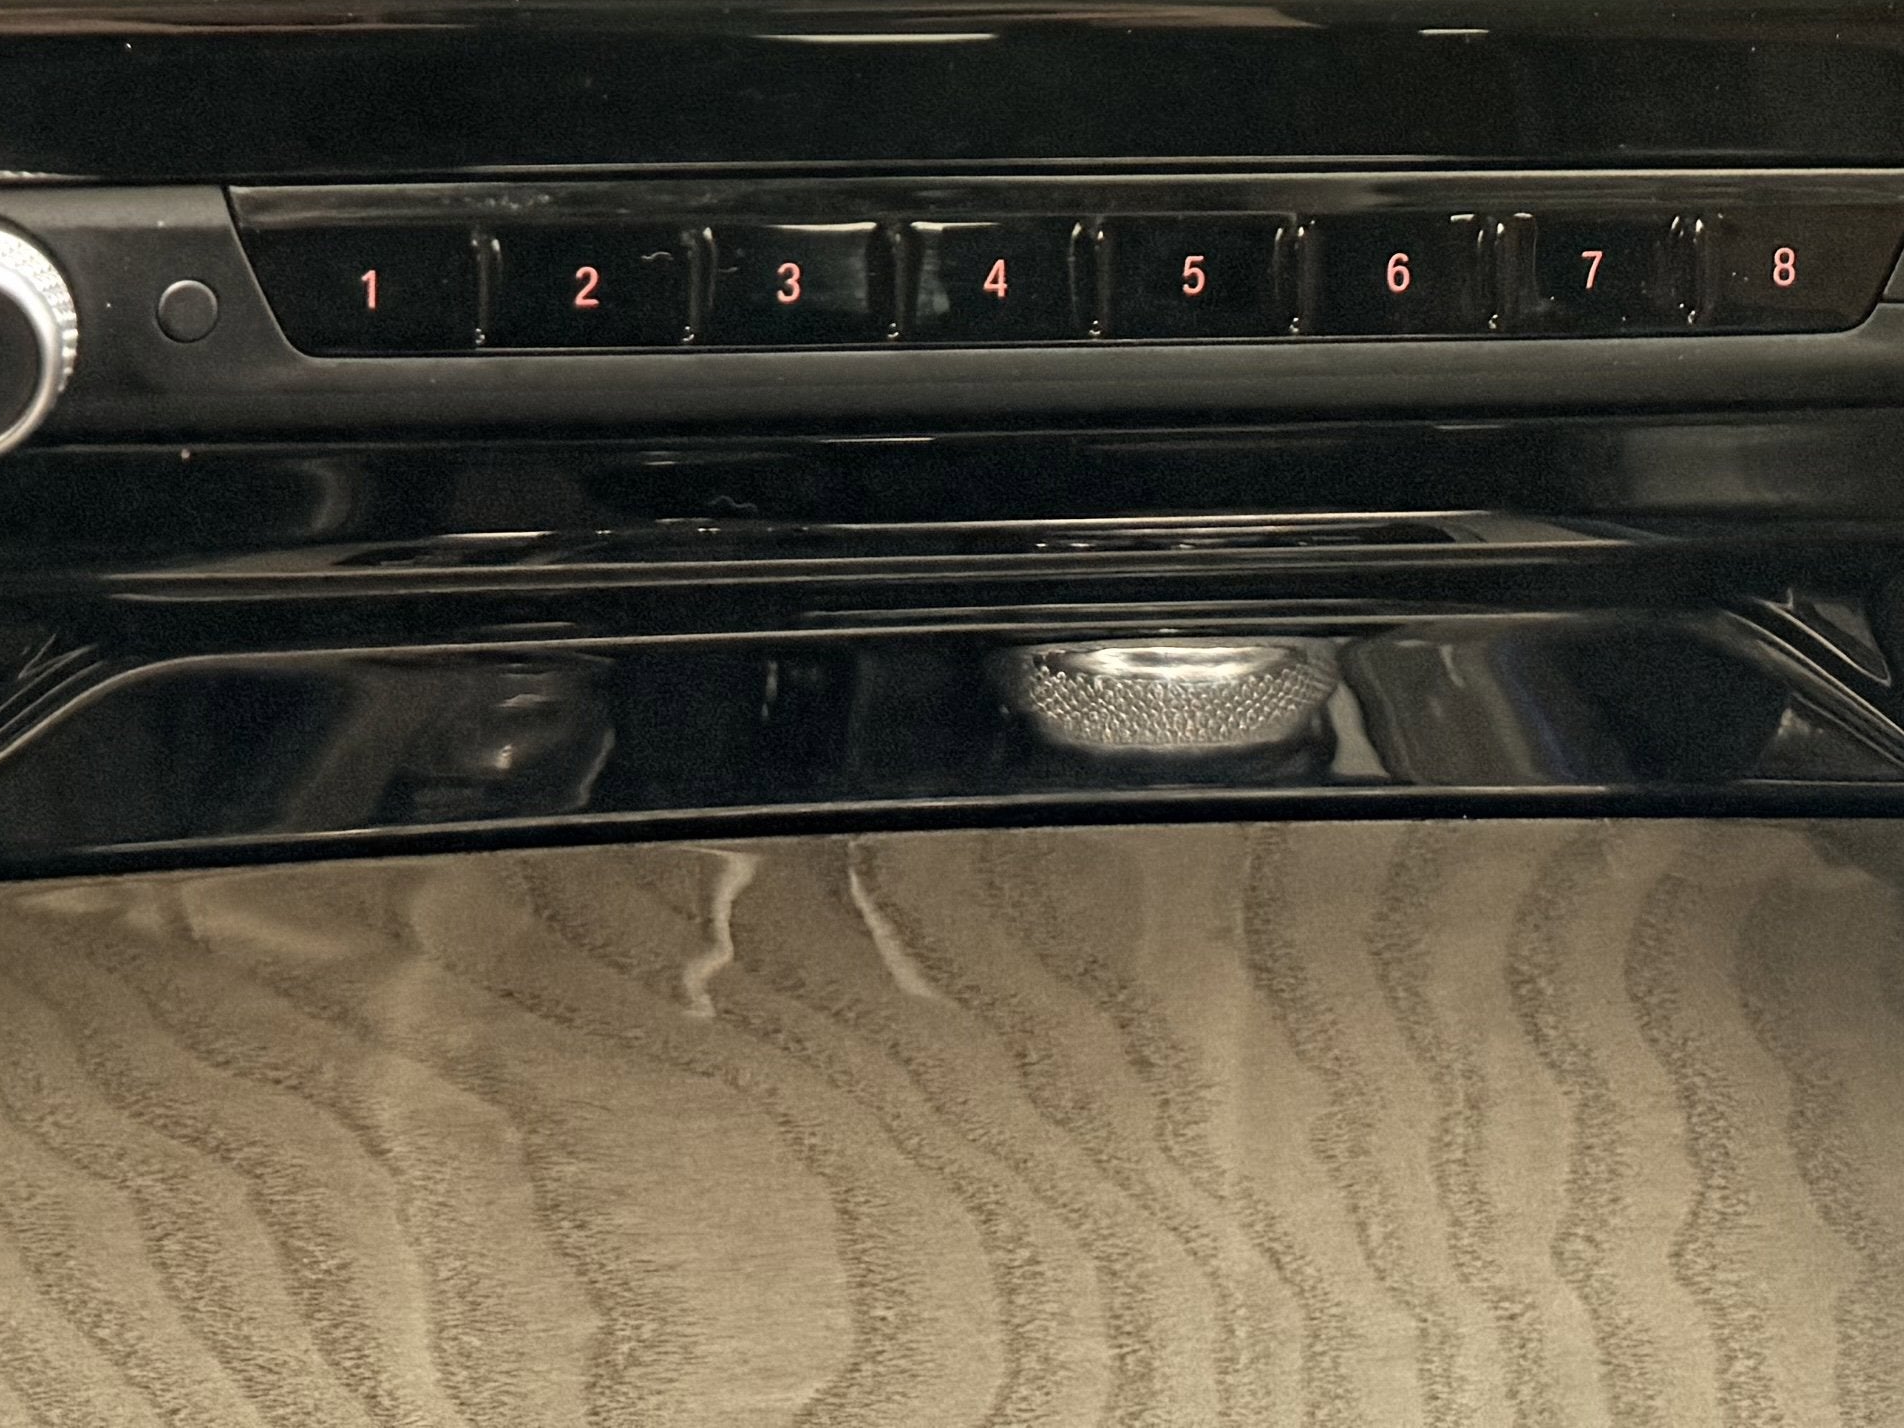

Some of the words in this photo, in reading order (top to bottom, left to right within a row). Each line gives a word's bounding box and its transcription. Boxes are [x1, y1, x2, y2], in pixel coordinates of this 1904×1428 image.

[573, 265, 601, 309] 2
[774, 262, 802, 305] 3
[982, 258, 1009, 298] 4
[1181, 254, 1206, 296] 5
[1385, 251, 1411, 293] 6
[1580, 250, 1604, 291] 7
[1770, 246, 1797, 288] 8
[359, 269, 378, 309] 1
